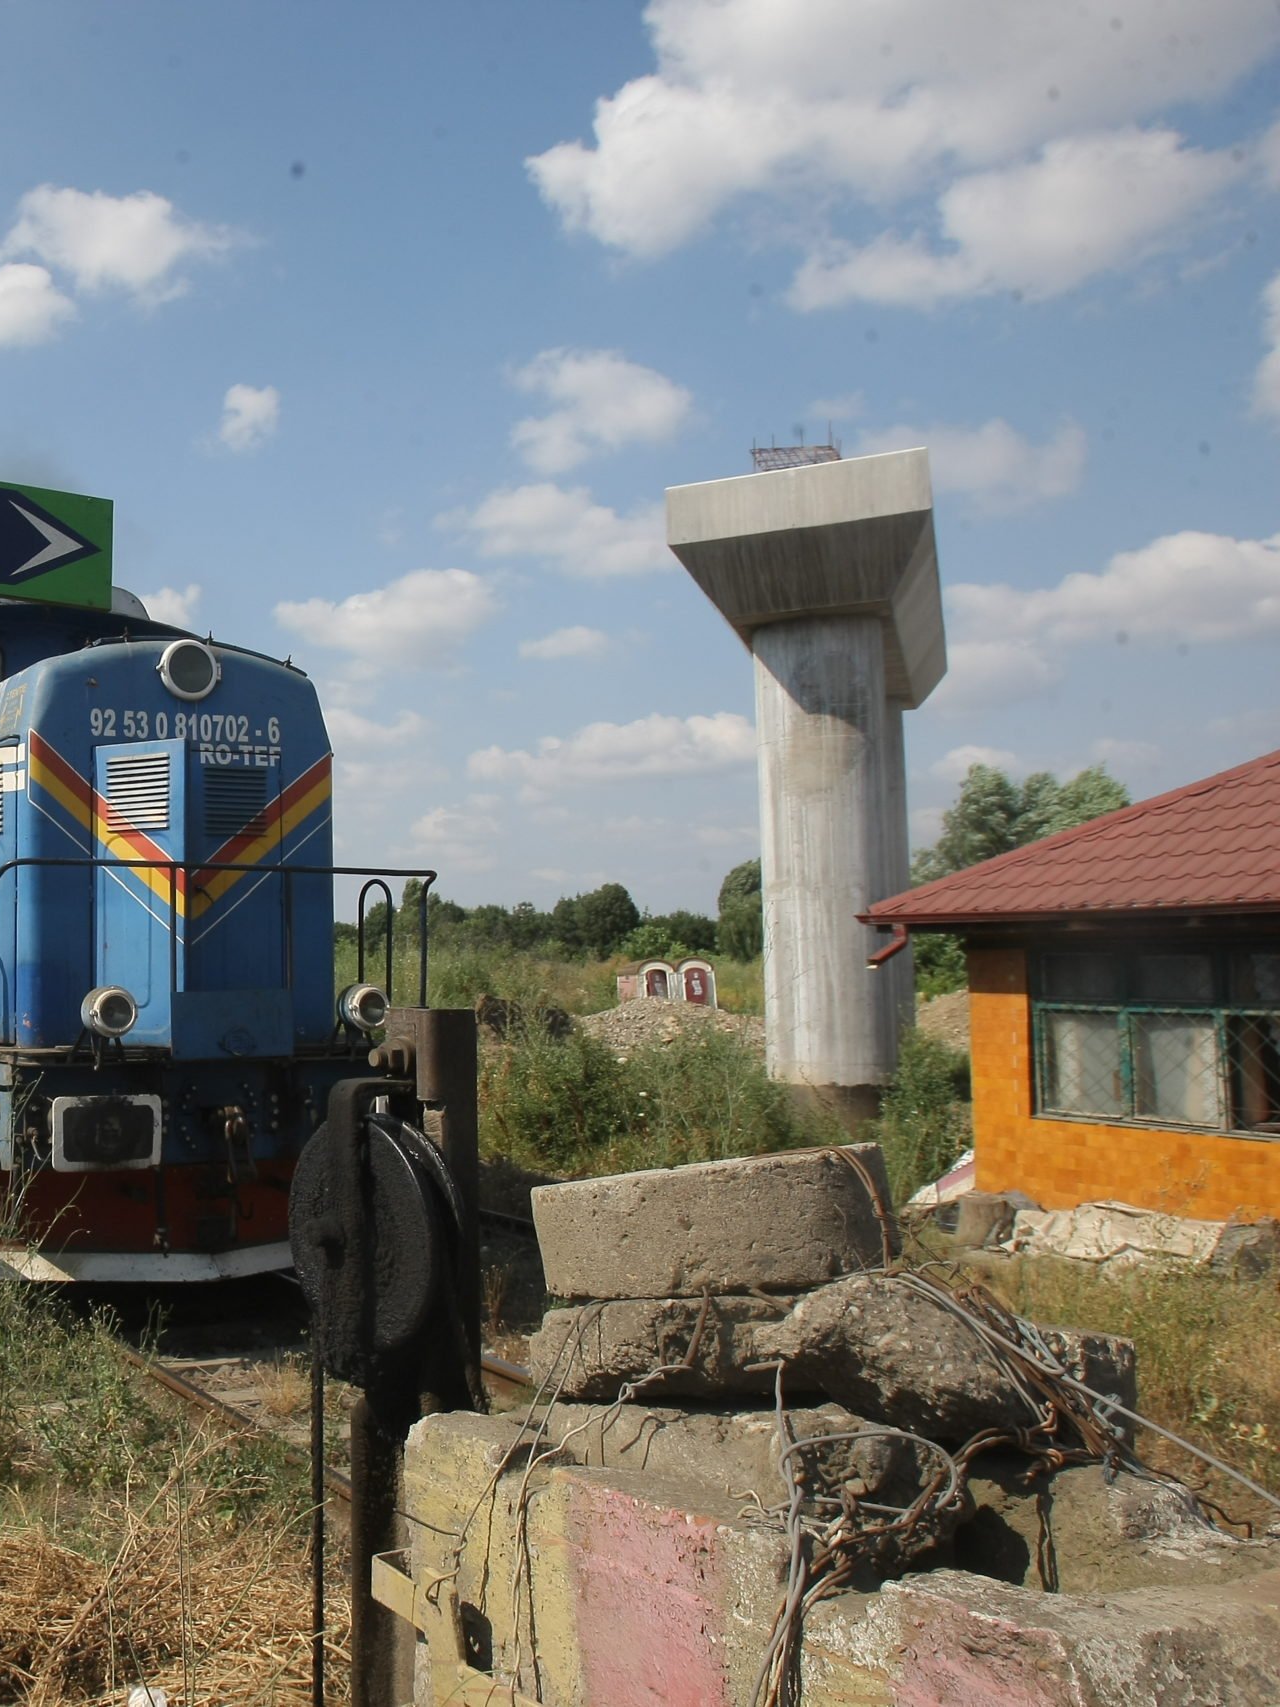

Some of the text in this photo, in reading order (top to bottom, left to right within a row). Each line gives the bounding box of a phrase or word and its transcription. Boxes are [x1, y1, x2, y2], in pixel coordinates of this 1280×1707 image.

[90, 707, 117, 737] 92
[123, 710, 150, 739] 53
[155, 711, 168, 740] 0
[174, 712, 249, 743] 810702
[267, 716, 281, 744] 6
[199, 743, 282, 767] RO-TEF
